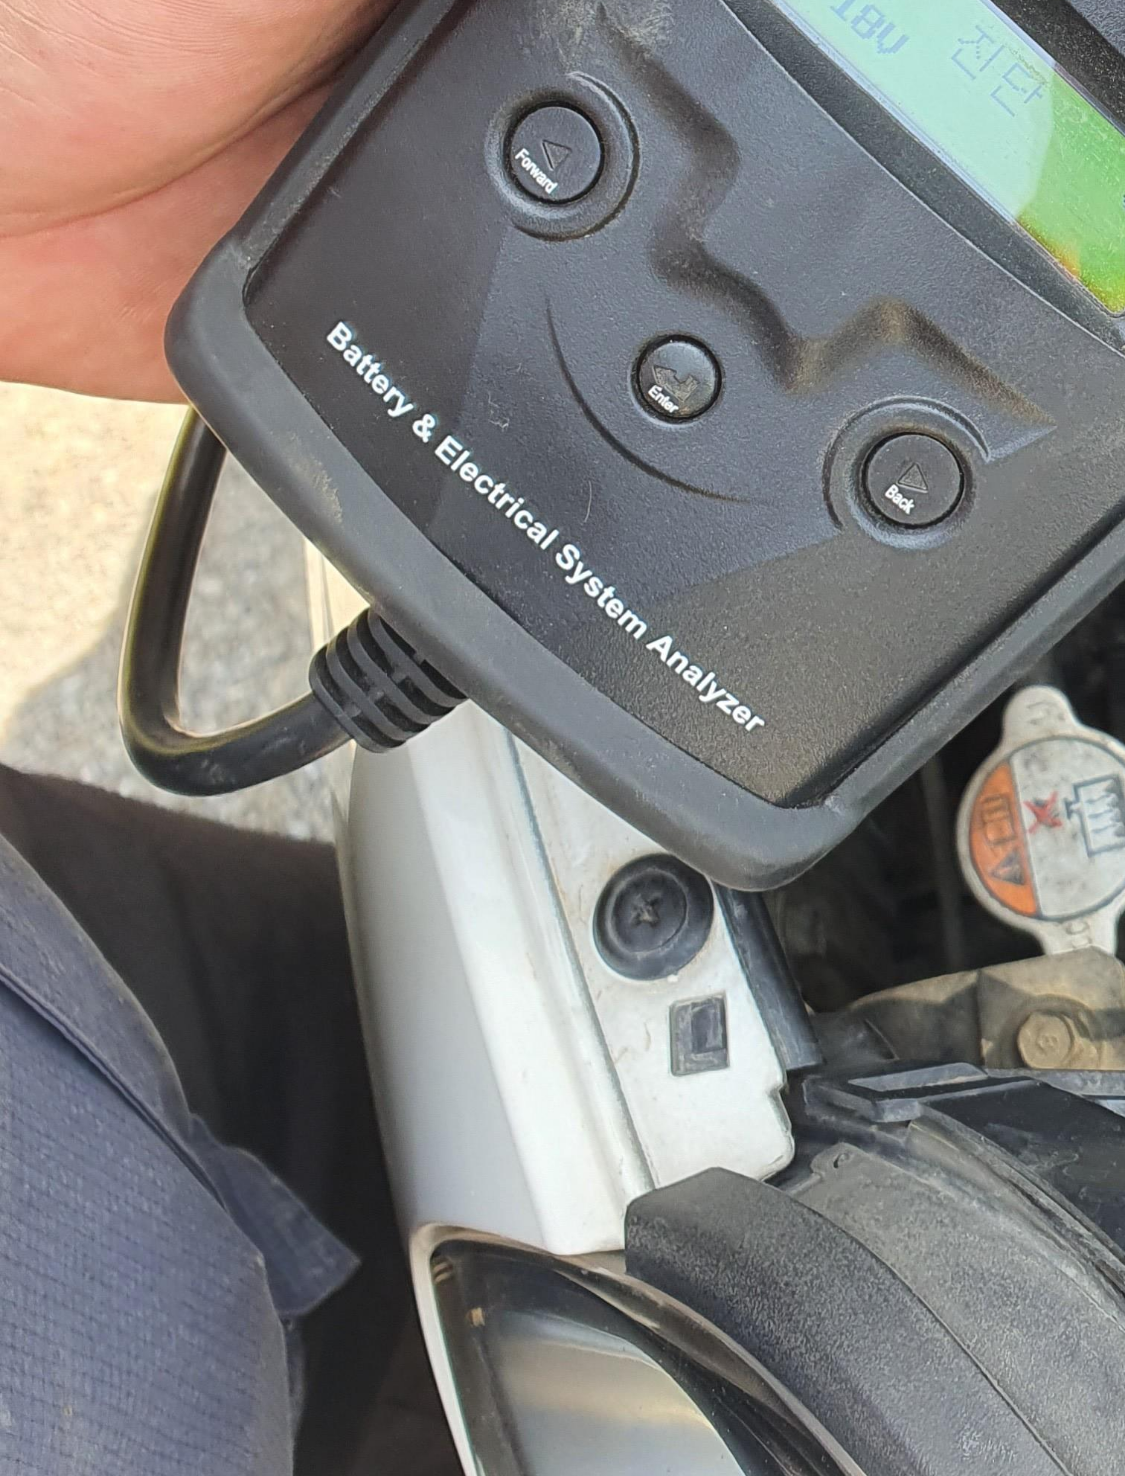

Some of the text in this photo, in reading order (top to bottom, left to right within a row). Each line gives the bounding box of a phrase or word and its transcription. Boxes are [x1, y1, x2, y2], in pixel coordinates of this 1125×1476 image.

[950, 23, 1044, 117] 진단
[514, 148, 558, 194] Forward
[648, 384, 679, 413] Enter
[884, 484, 915, 515] Back
[326, 321, 766, 732] Battery & Electrical System Analyzer
